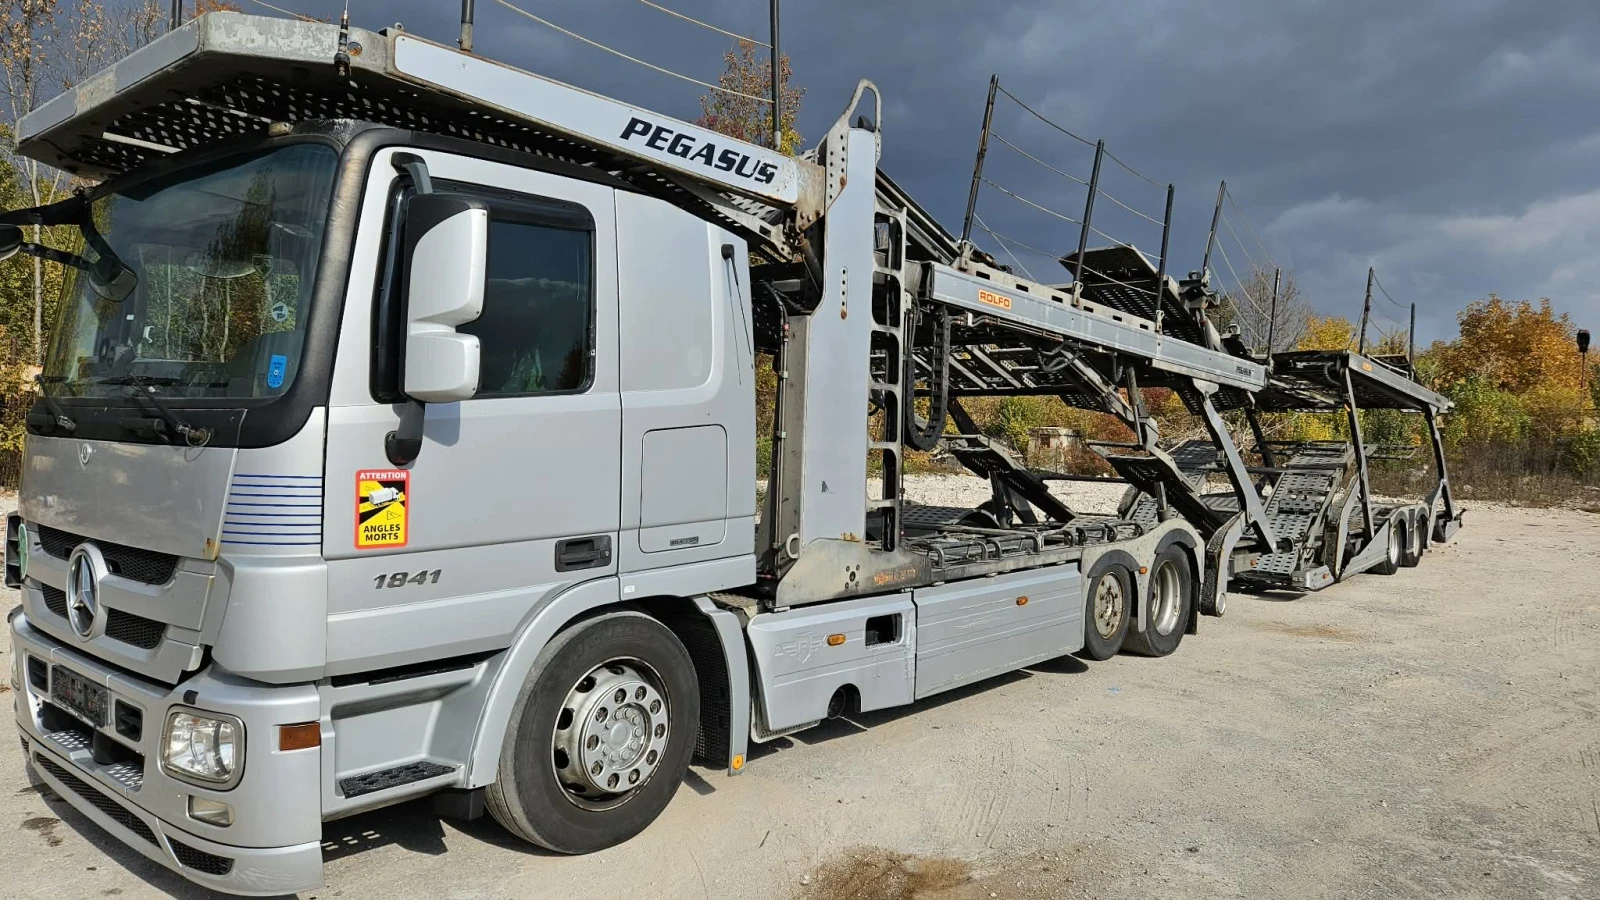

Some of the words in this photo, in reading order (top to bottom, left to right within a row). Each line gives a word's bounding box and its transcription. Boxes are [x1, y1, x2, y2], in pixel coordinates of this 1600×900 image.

[619, 117, 778, 184] PEGASUS
[980, 291, 1010, 307] ROLFO
[360, 472, 406, 480] ATTENTION
[363, 524, 401, 533] ANGLES
[365, 533, 399, 541] MORTS
[373, 569, 442, 590] 1841
